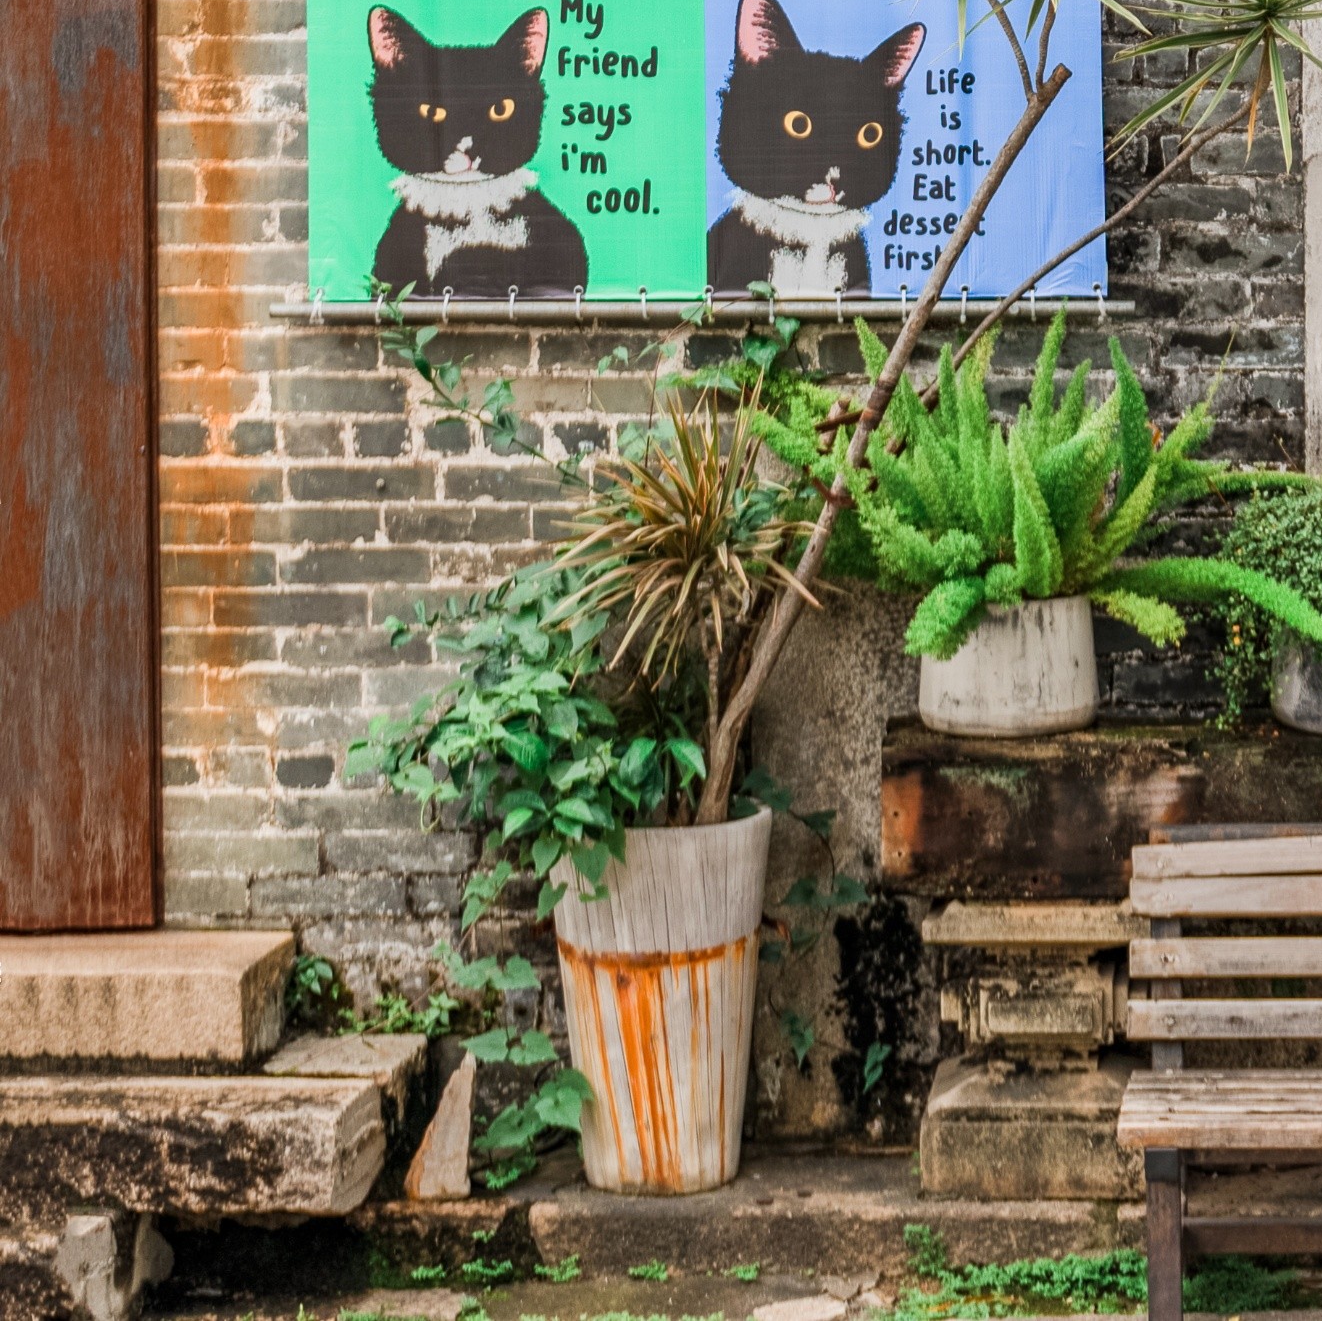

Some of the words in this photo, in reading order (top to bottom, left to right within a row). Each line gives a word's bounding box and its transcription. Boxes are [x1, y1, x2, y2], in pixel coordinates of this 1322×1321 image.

[557, 45, 659, 79] friend
[925, 67, 976, 96] Life
[560, 101, 632, 142] says
[940, 104, 962, 130] is
[561, 144, 608, 175] i'm
[911, 139, 992, 166] short.
[586, 178, 660, 215] cool.
[912, 173, 957, 201] Eat
[883, 209, 986, 236] desset
